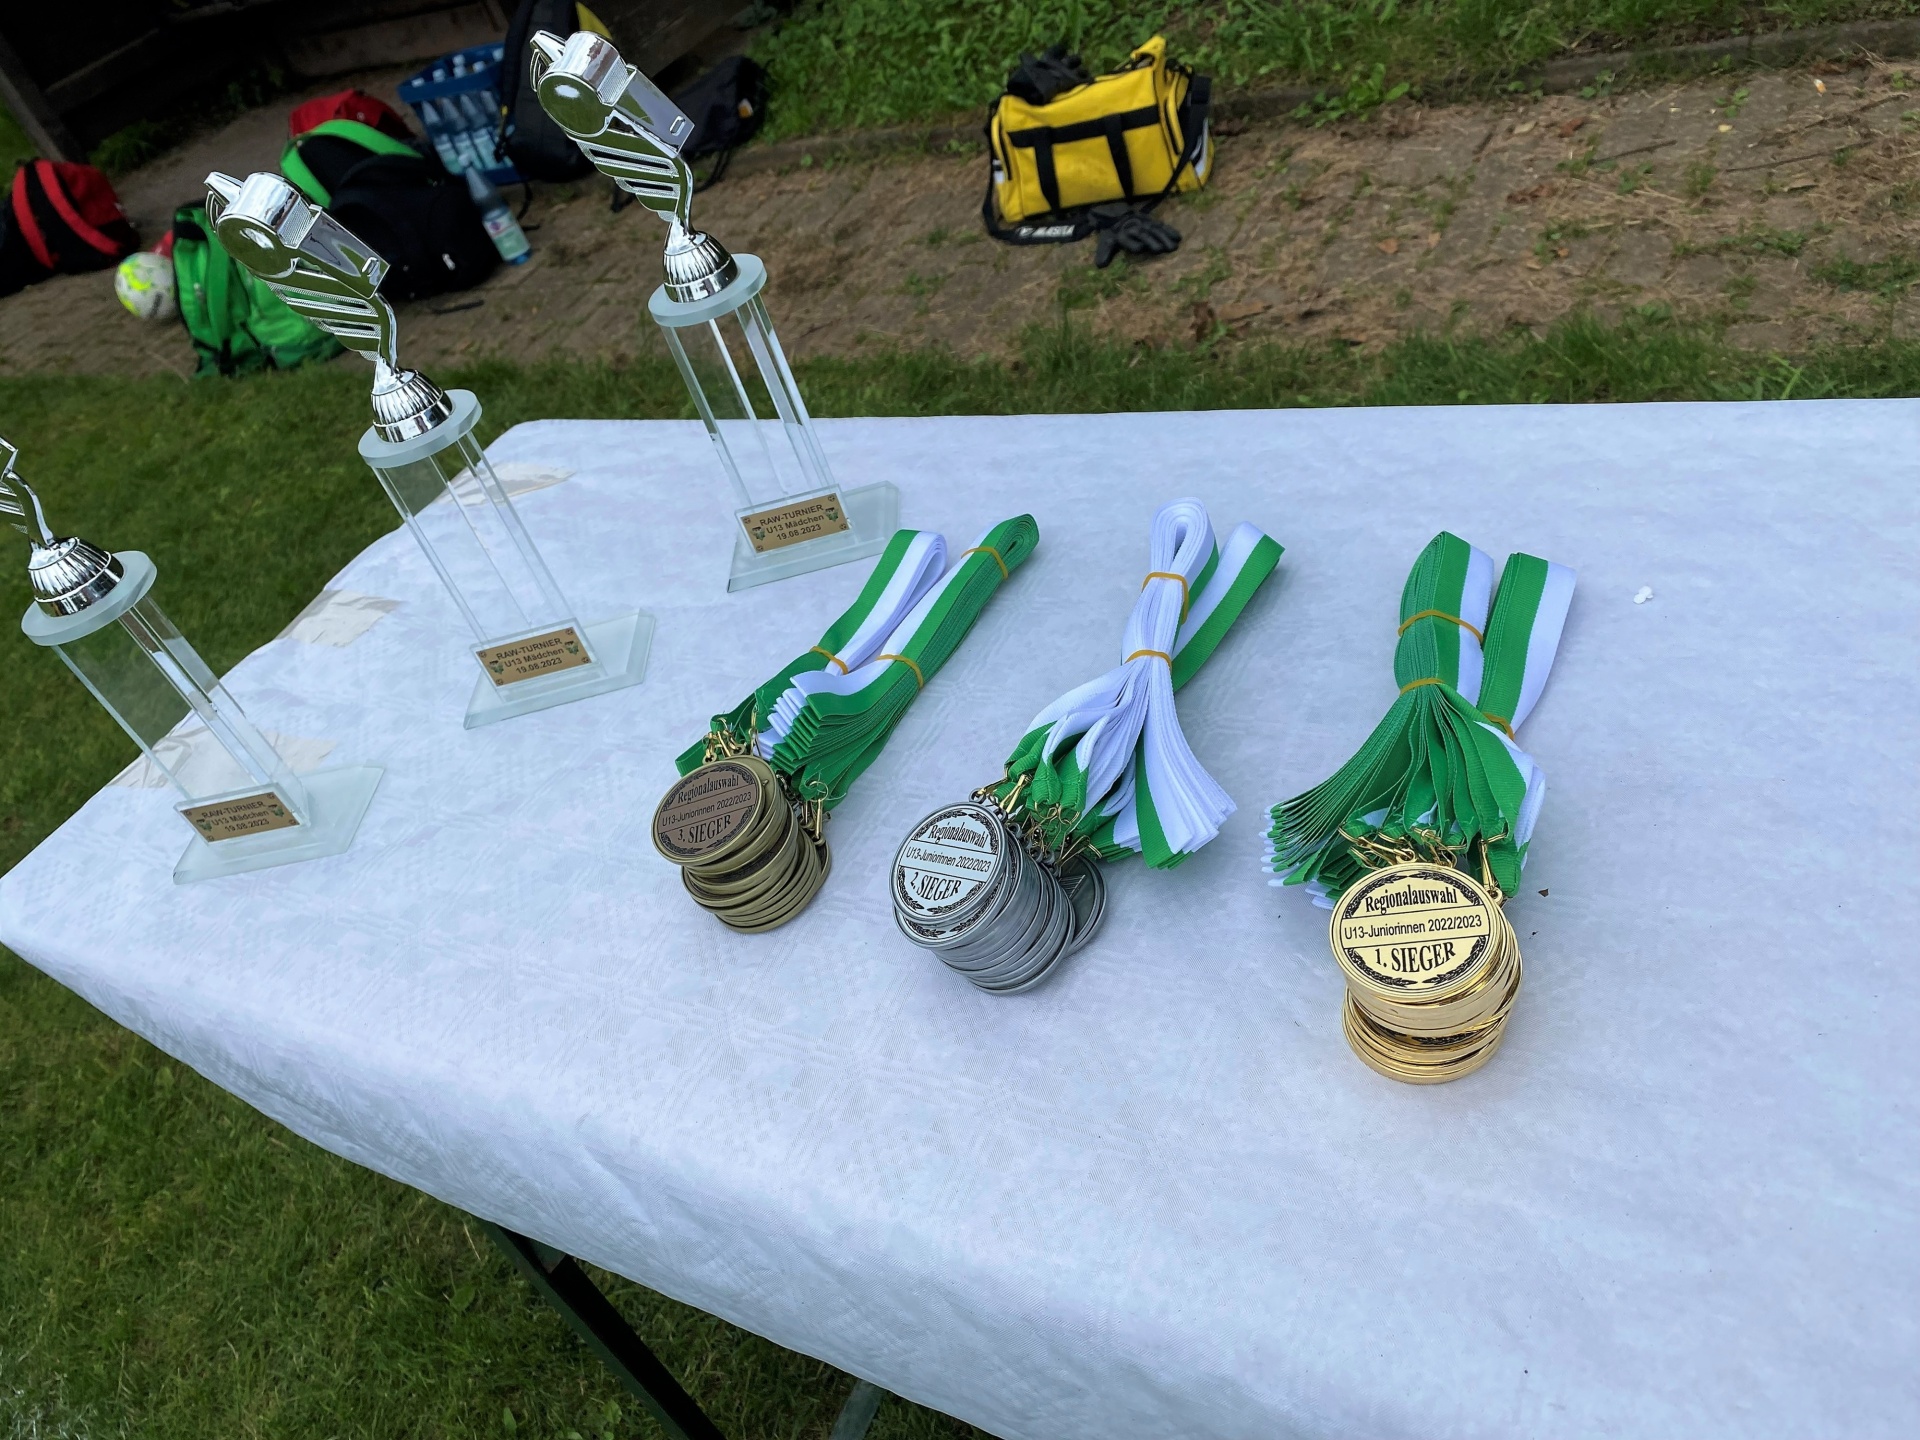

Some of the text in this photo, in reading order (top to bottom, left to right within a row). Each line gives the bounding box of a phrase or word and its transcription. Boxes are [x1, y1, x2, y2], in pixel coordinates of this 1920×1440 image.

[759, 504, 824, 527] RAW-TURNIER
[766, 514, 825, 534] U13 Mädchen
[776, 523, 822, 541] 19.08.2023
[496, 637, 563, 660] RAW-TURNIER
[504, 648, 565, 668] U13 Mädchen
[516, 657, 563, 674] 19.08.2023
[677, 774, 740, 804] Regionalauswahl
[201, 800, 267, 819] RAW-TURNIER
[211, 810, 270, 826] U13 Mädchen
[662, 791, 752, 827] U13-Juniorinnen 2022/2023
[224, 818, 270, 833] 19.08.2023
[677, 814, 732, 844] 3. SIEGER
[928, 822, 990, 849] Regionalauswahl
[905, 847, 992, 873] U13-Juniorinnen 2022/2023
[910, 871, 962, 901] 2. SIEGER
[1365, 884, 1458, 915] Regionalauswahl
[1344, 914, 1482, 940] U13-Juniorinnen 2022/2023
[1375, 941, 1457, 973] 1. SIEGER
